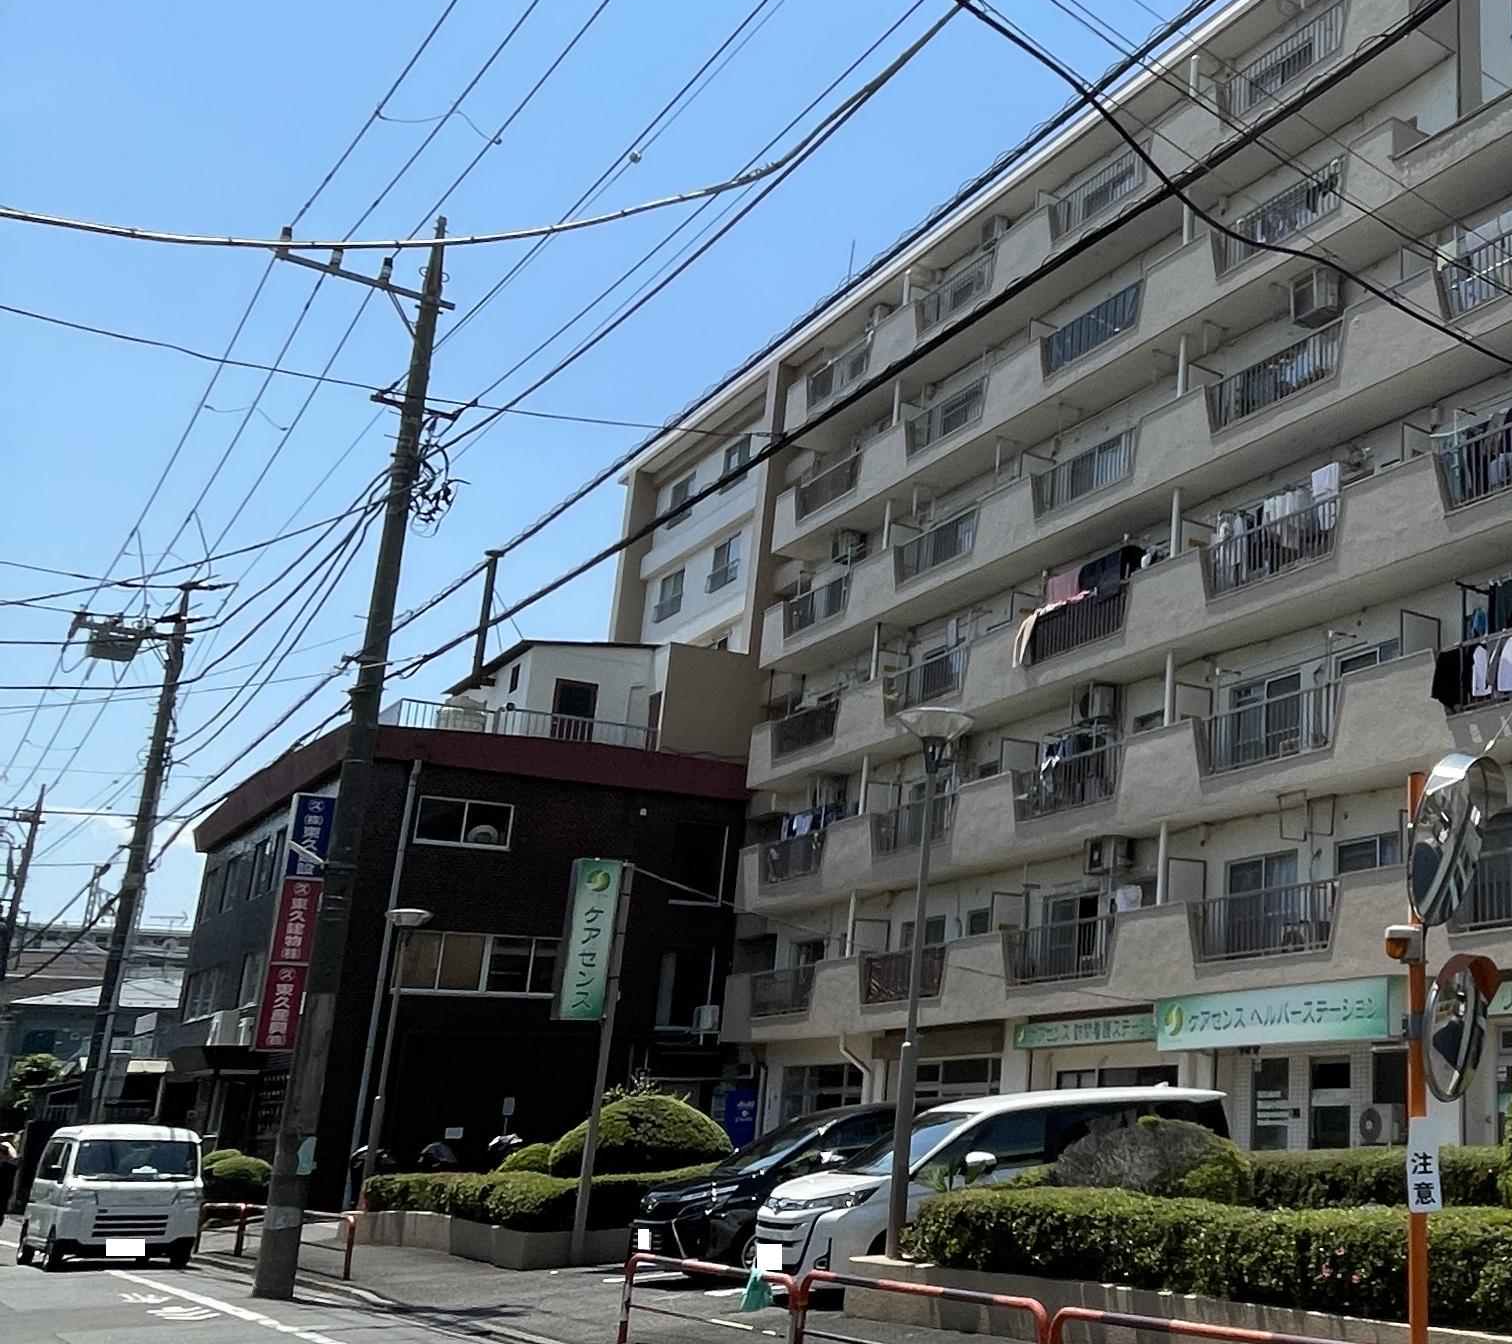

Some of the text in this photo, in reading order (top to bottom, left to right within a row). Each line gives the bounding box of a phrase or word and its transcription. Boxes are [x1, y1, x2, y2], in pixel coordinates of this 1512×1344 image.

[571, 906, 604, 1009] ケアセンス
[1188, 1007, 1246, 1033] ケアセンス
[1411, 1151, 1436, 1205] 注意
